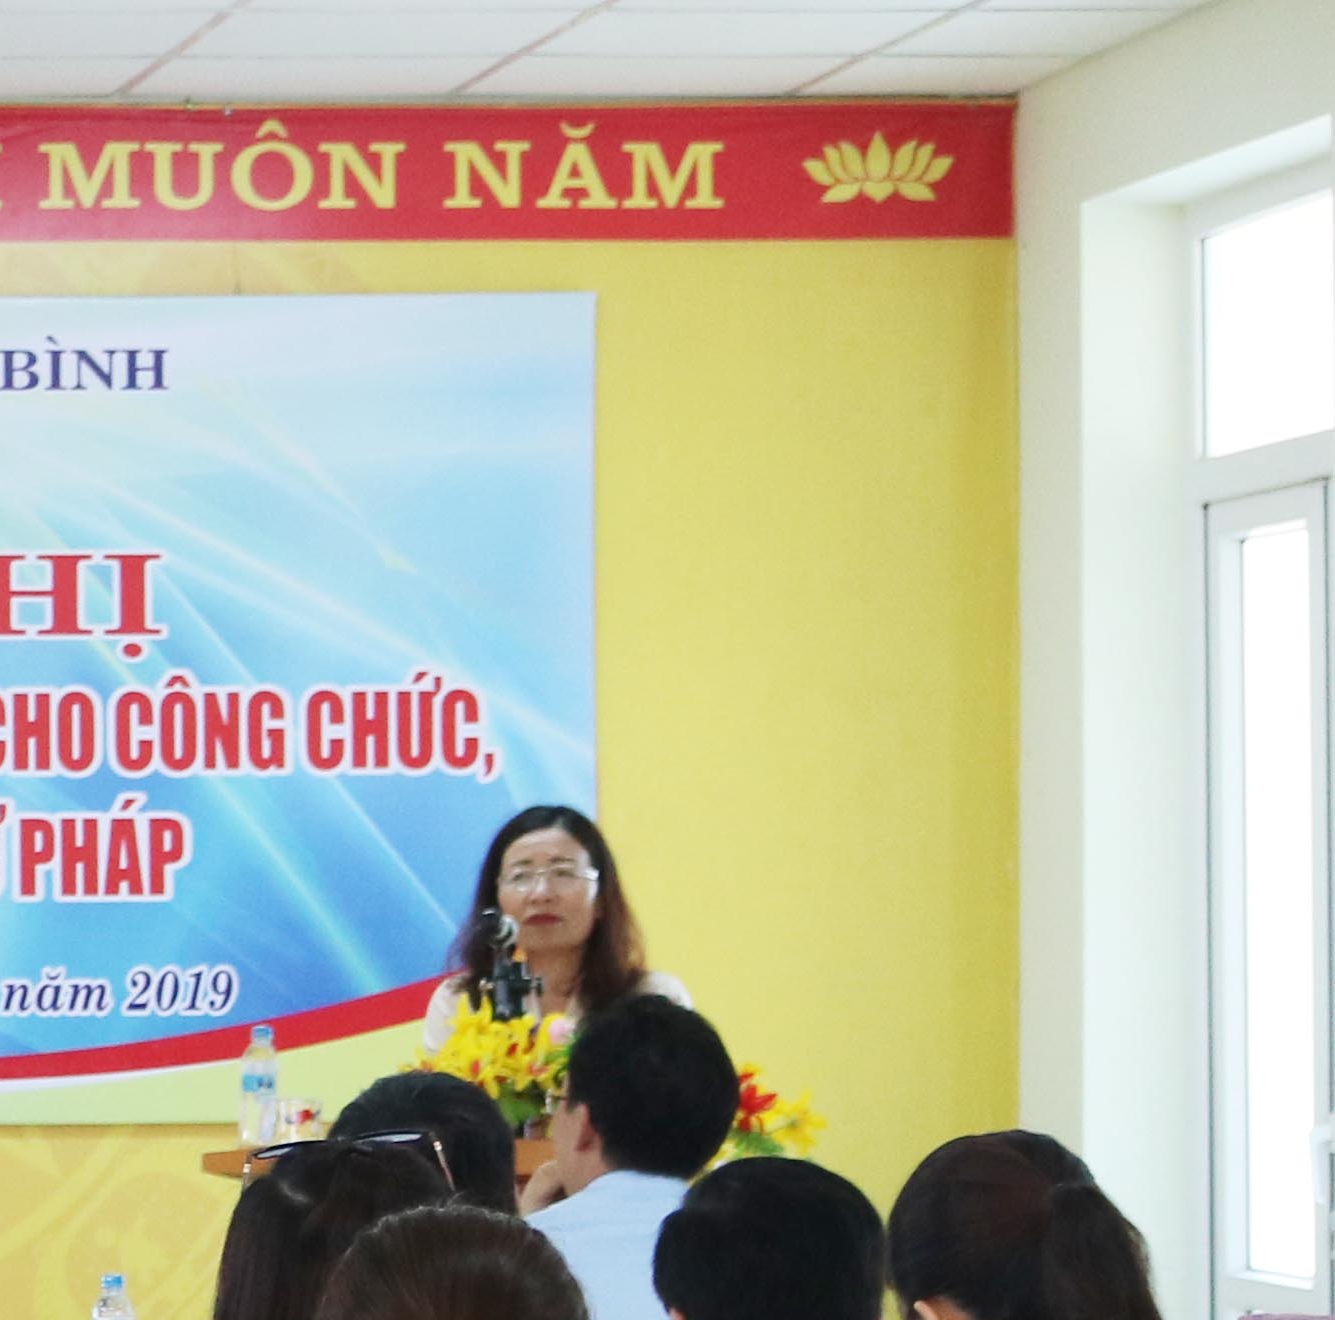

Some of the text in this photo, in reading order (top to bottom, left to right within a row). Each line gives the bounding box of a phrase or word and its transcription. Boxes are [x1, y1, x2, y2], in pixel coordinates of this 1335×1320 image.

[39, 119, 406, 210] MUÔN
[444, 124, 724, 209] NĂM
[0, 336, 167, 390] BÌNH
[116, 675, 285, 771] CÔNG
[306, 671, 496, 780] CHỨC,
[21, 799, 184, 896] PHÁP
[4, 975, 106, 1012] năm
[126, 970, 235, 1012] 2019
